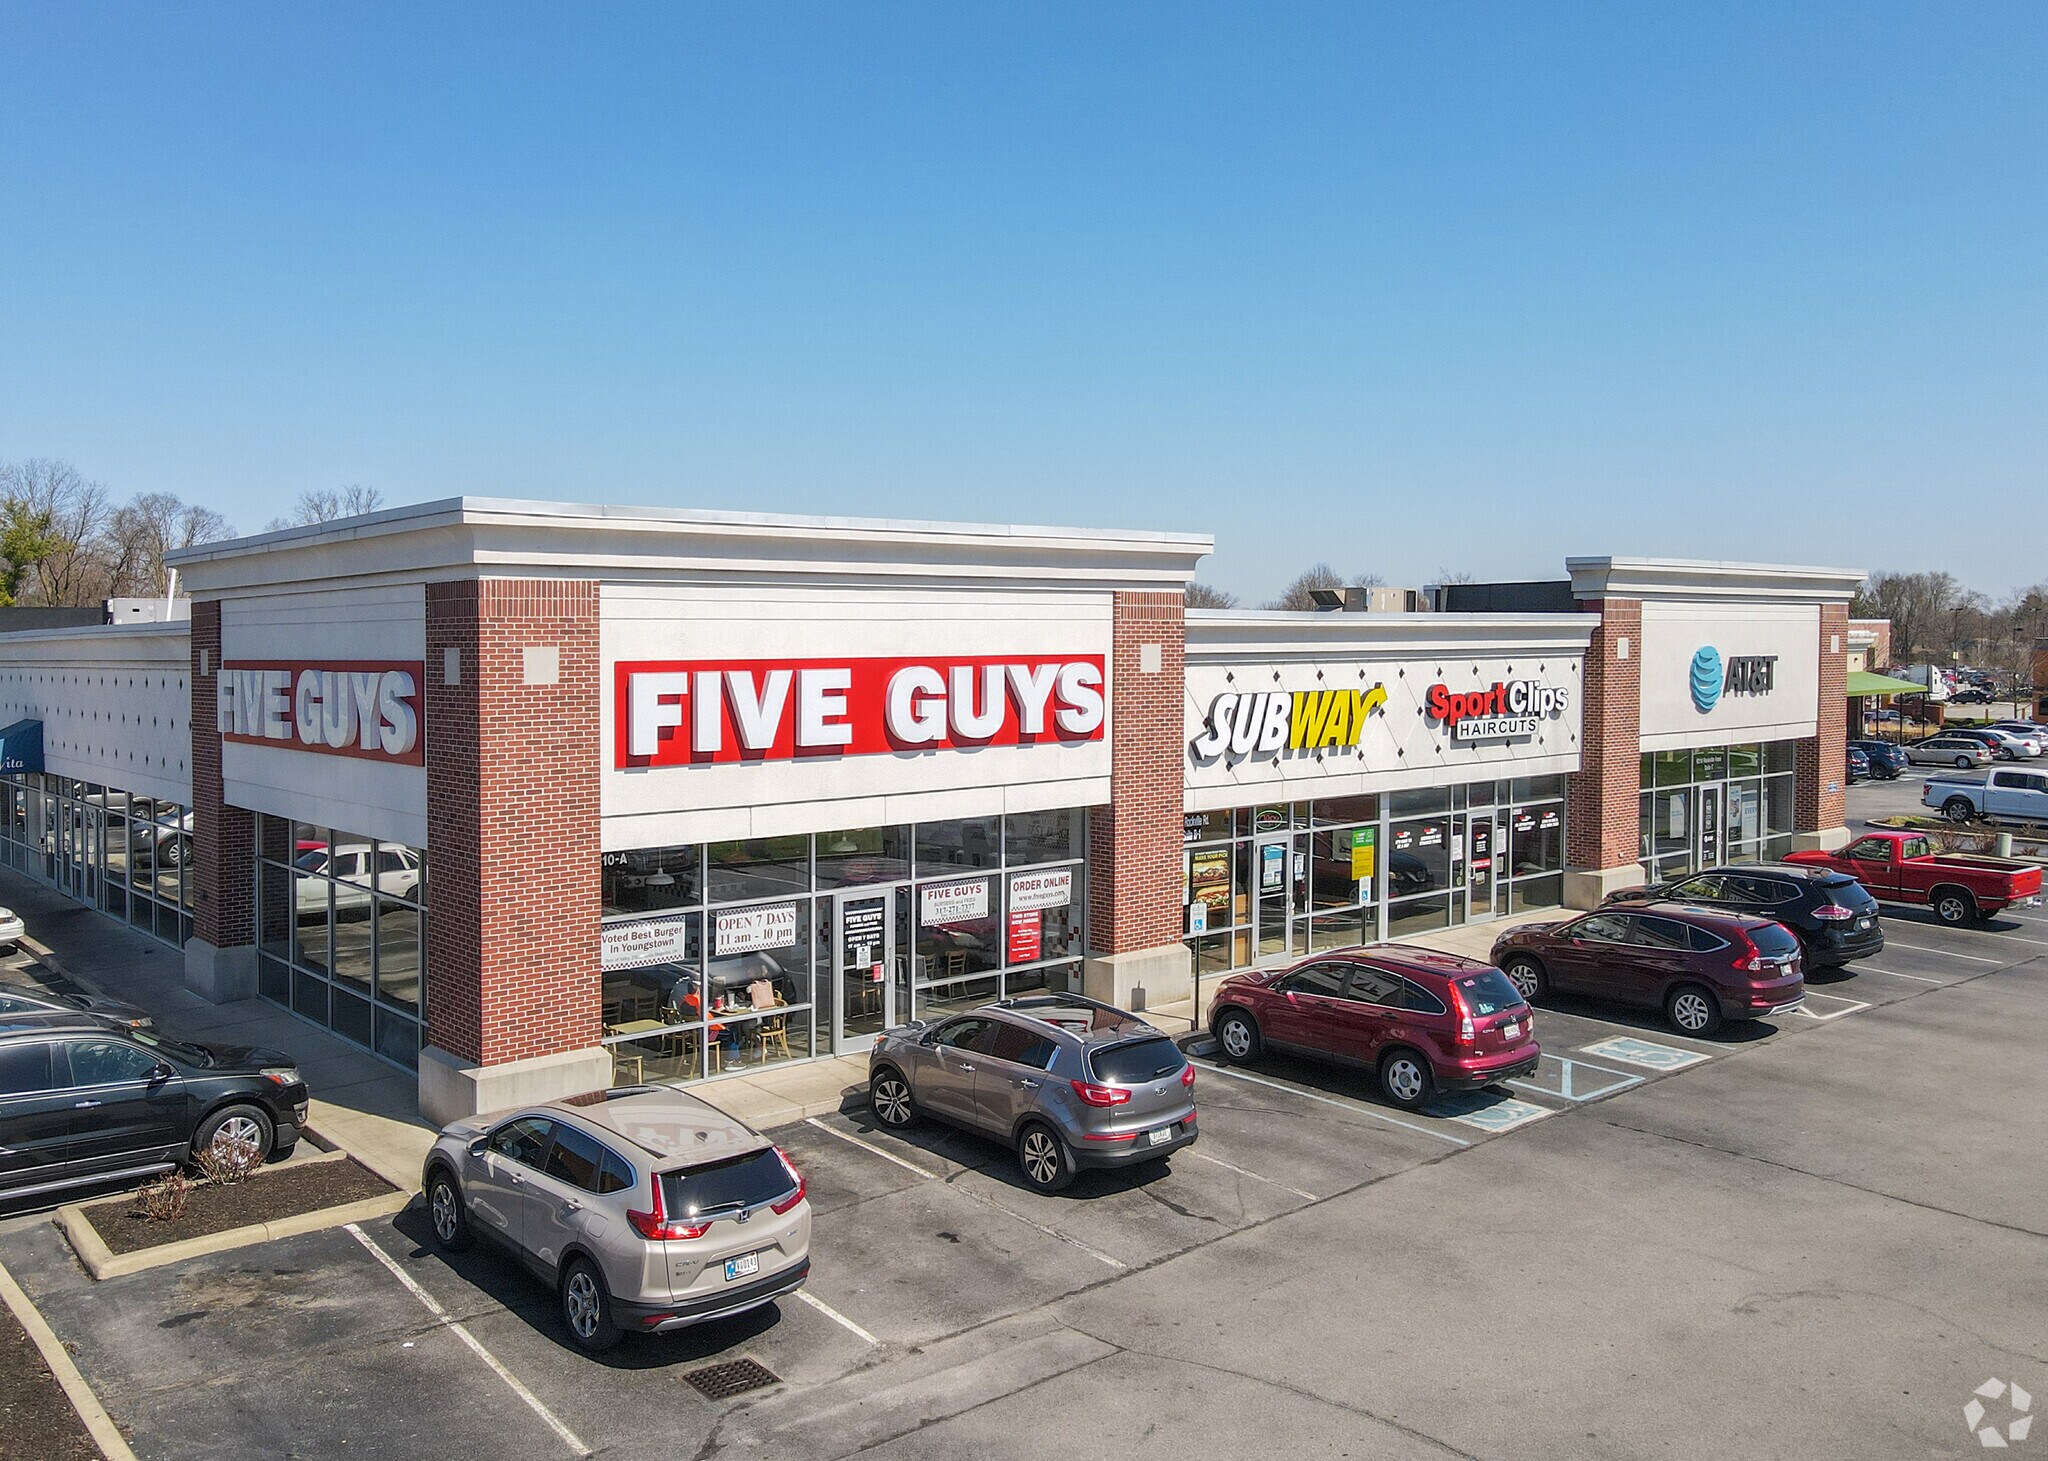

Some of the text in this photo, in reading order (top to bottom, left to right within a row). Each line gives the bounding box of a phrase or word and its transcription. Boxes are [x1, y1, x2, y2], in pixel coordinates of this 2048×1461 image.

[1724, 656, 1778, 696] AT&T
[628, 662, 1104, 756] FIVE GUYS
[1428, 680, 1569, 727] Sport Clips
[217, 670, 417, 755] FIVE GUYS
[1191, 682, 1388, 761] SUBWAY
[1460, 719, 1537, 736] HAIRCUTS
[928, 885, 982, 900] FIVE GUYS
[1013, 876, 1069, 892] ORDER ONLINE
[718, 912, 795, 931] OPEN 7 DAYS
[845, 913, 882, 924] FIVE GUYS
[601, 926, 683, 943] Voted Best Burger
[720, 934, 730, 945] 11
[734, 934, 750, 944] am
[763, 929, 773, 940] 10
[776, 928, 792, 940] pm
[621, 938, 675, 951] Youngstown
